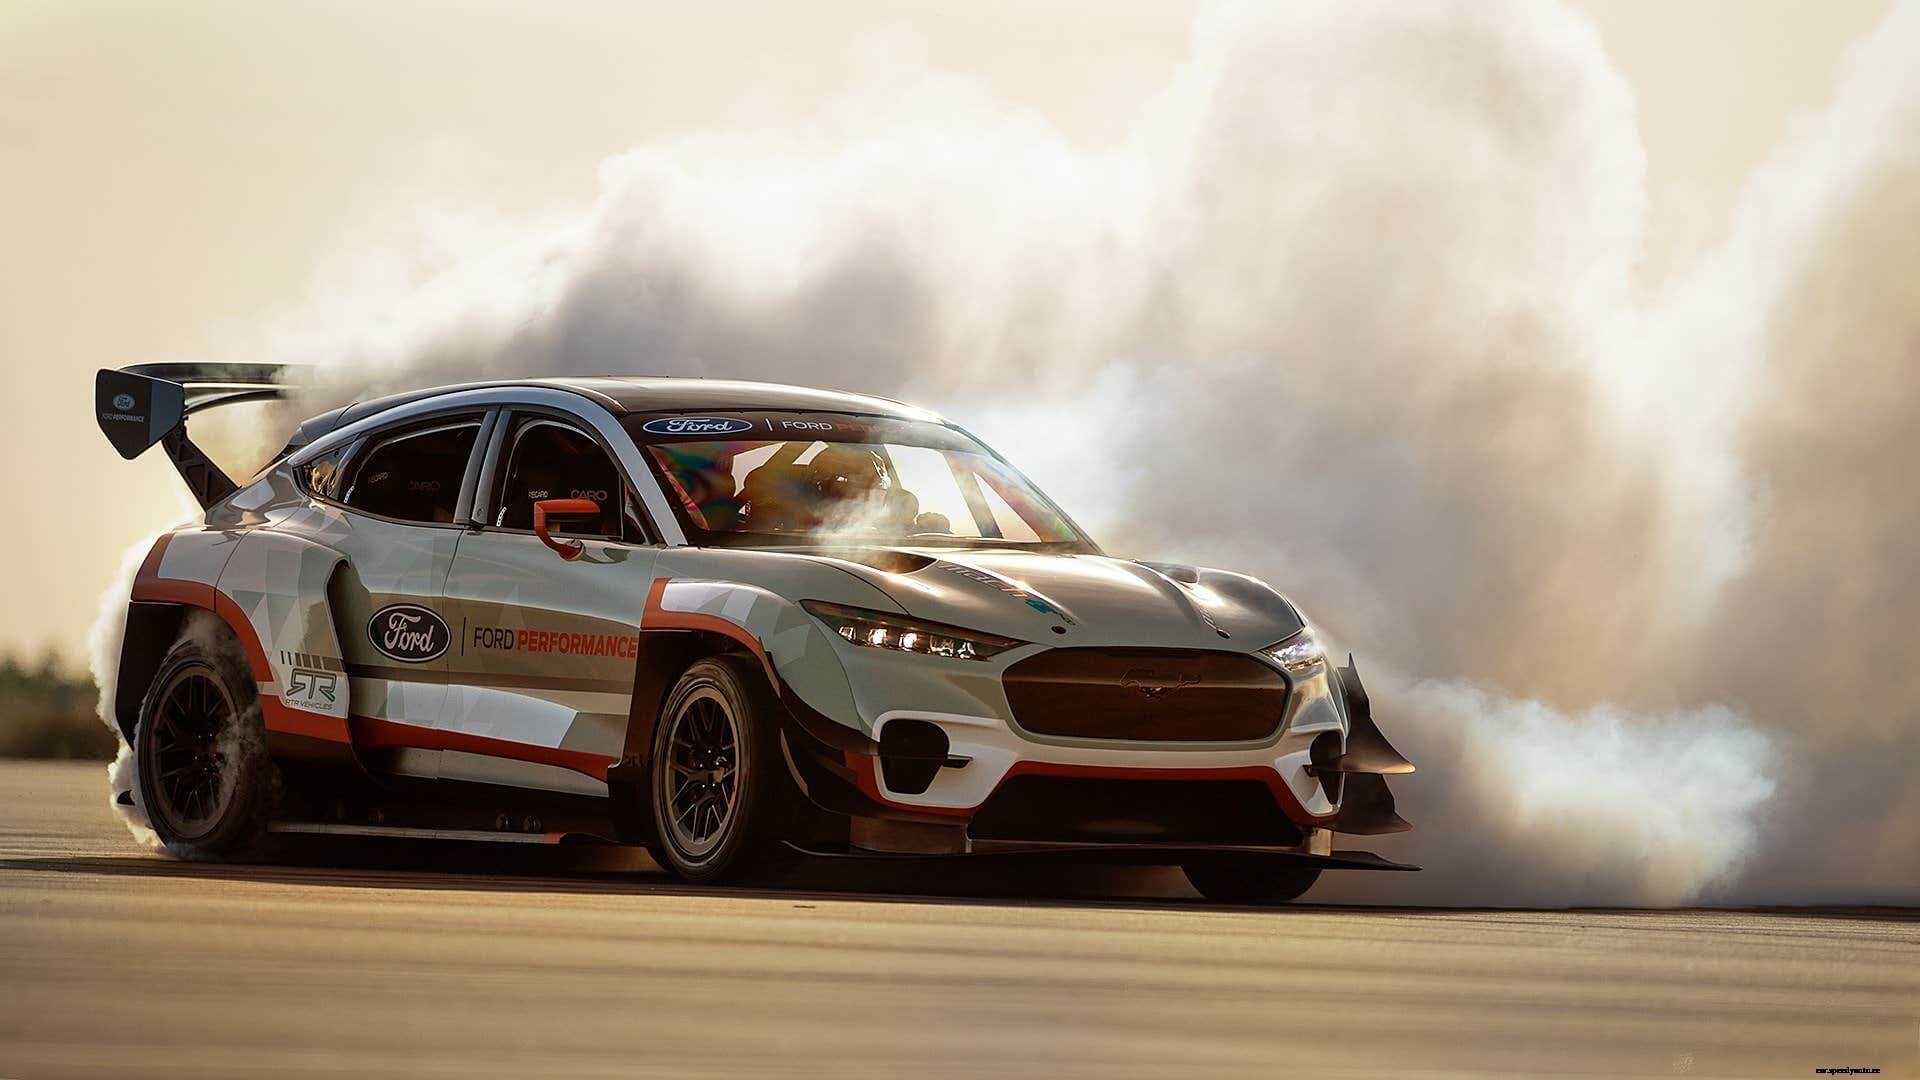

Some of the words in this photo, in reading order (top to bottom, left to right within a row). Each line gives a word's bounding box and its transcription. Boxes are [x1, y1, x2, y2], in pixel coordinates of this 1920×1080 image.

[667, 419, 733, 431] Ford
[782, 421, 833, 430] FORD
[384, 612, 434, 652] Ford
[474, 627, 514, 650] FORD
[517, 630, 638, 658] PERFORMANCE
